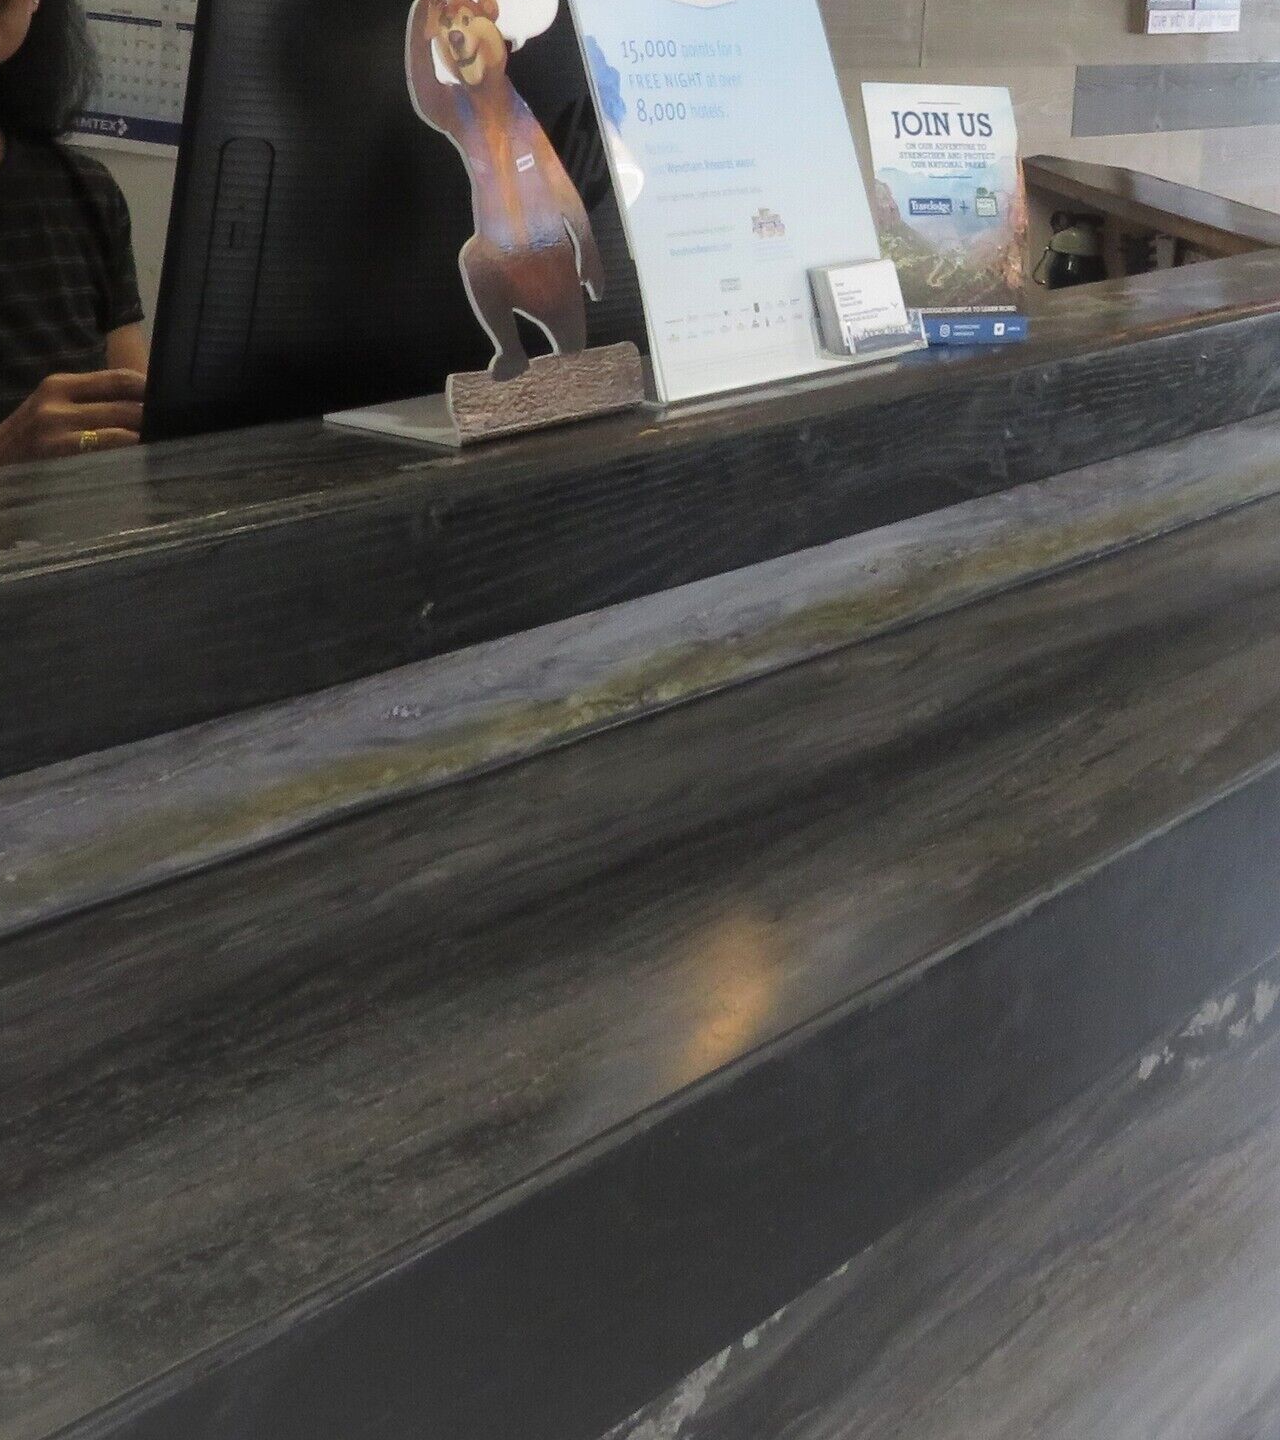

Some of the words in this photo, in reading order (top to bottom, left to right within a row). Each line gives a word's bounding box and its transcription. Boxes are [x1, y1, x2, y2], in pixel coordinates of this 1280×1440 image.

[621, 40, 677, 64] 15,000
[628, 73, 661, 89] FREE
[665, 72, 703, 88] NIGHT
[636, 98, 686, 125] 8,000
[891, 110, 951, 139] JOIN
[958, 111, 994, 138] US
[904, 142, 917, 150] ON
[918, 142, 934, 150] OUR
[935, 142, 976, 151] ADVENTURE
[977, 143, 987, 151] TO
[899, 151, 946, 160] STRENGTHEN
[947, 151, 962, 160] AND
[911, 160, 927, 169] OUR
[928, 160, 963, 169] NATIONAL
